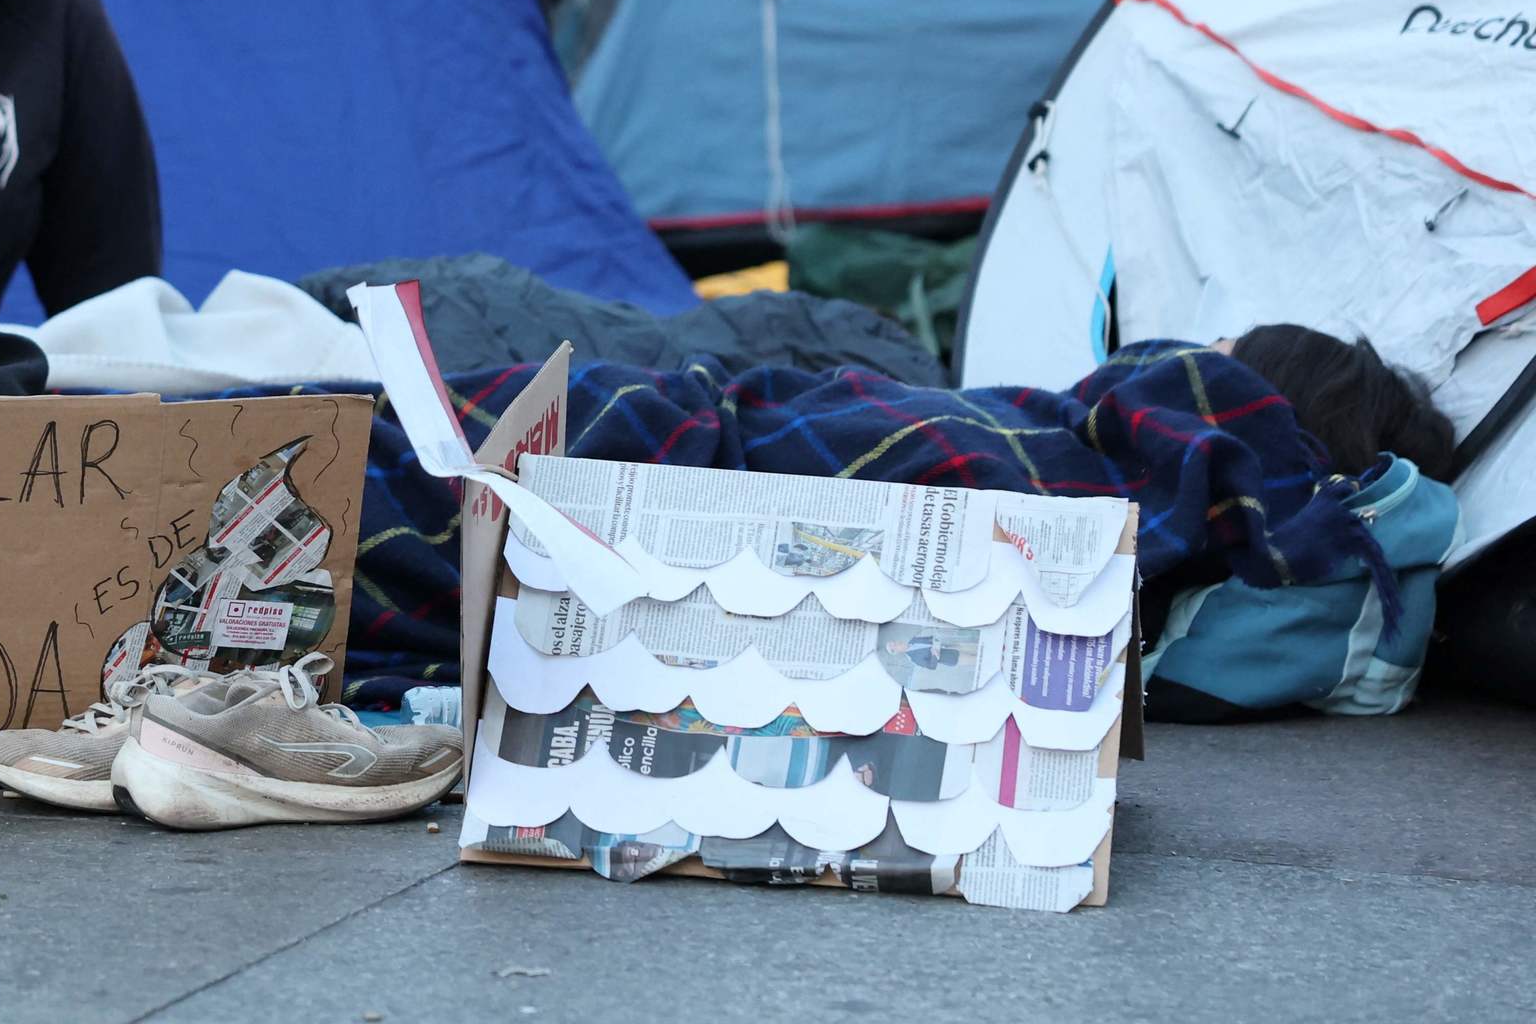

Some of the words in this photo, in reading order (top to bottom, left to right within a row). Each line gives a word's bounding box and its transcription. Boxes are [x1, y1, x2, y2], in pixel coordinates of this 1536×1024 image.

[925, 486, 941, 502] de
[943, 488, 959, 500] El
[919, 503, 936, 536] tasas
[935, 502, 956, 564] Gobierno
[147, 509, 196, 569] DE
[928, 565, 948, 589] deja
[554, 597, 571, 626] alza
[551, 626, 566, 640] el
[640, 726, 659, 774] encilla
